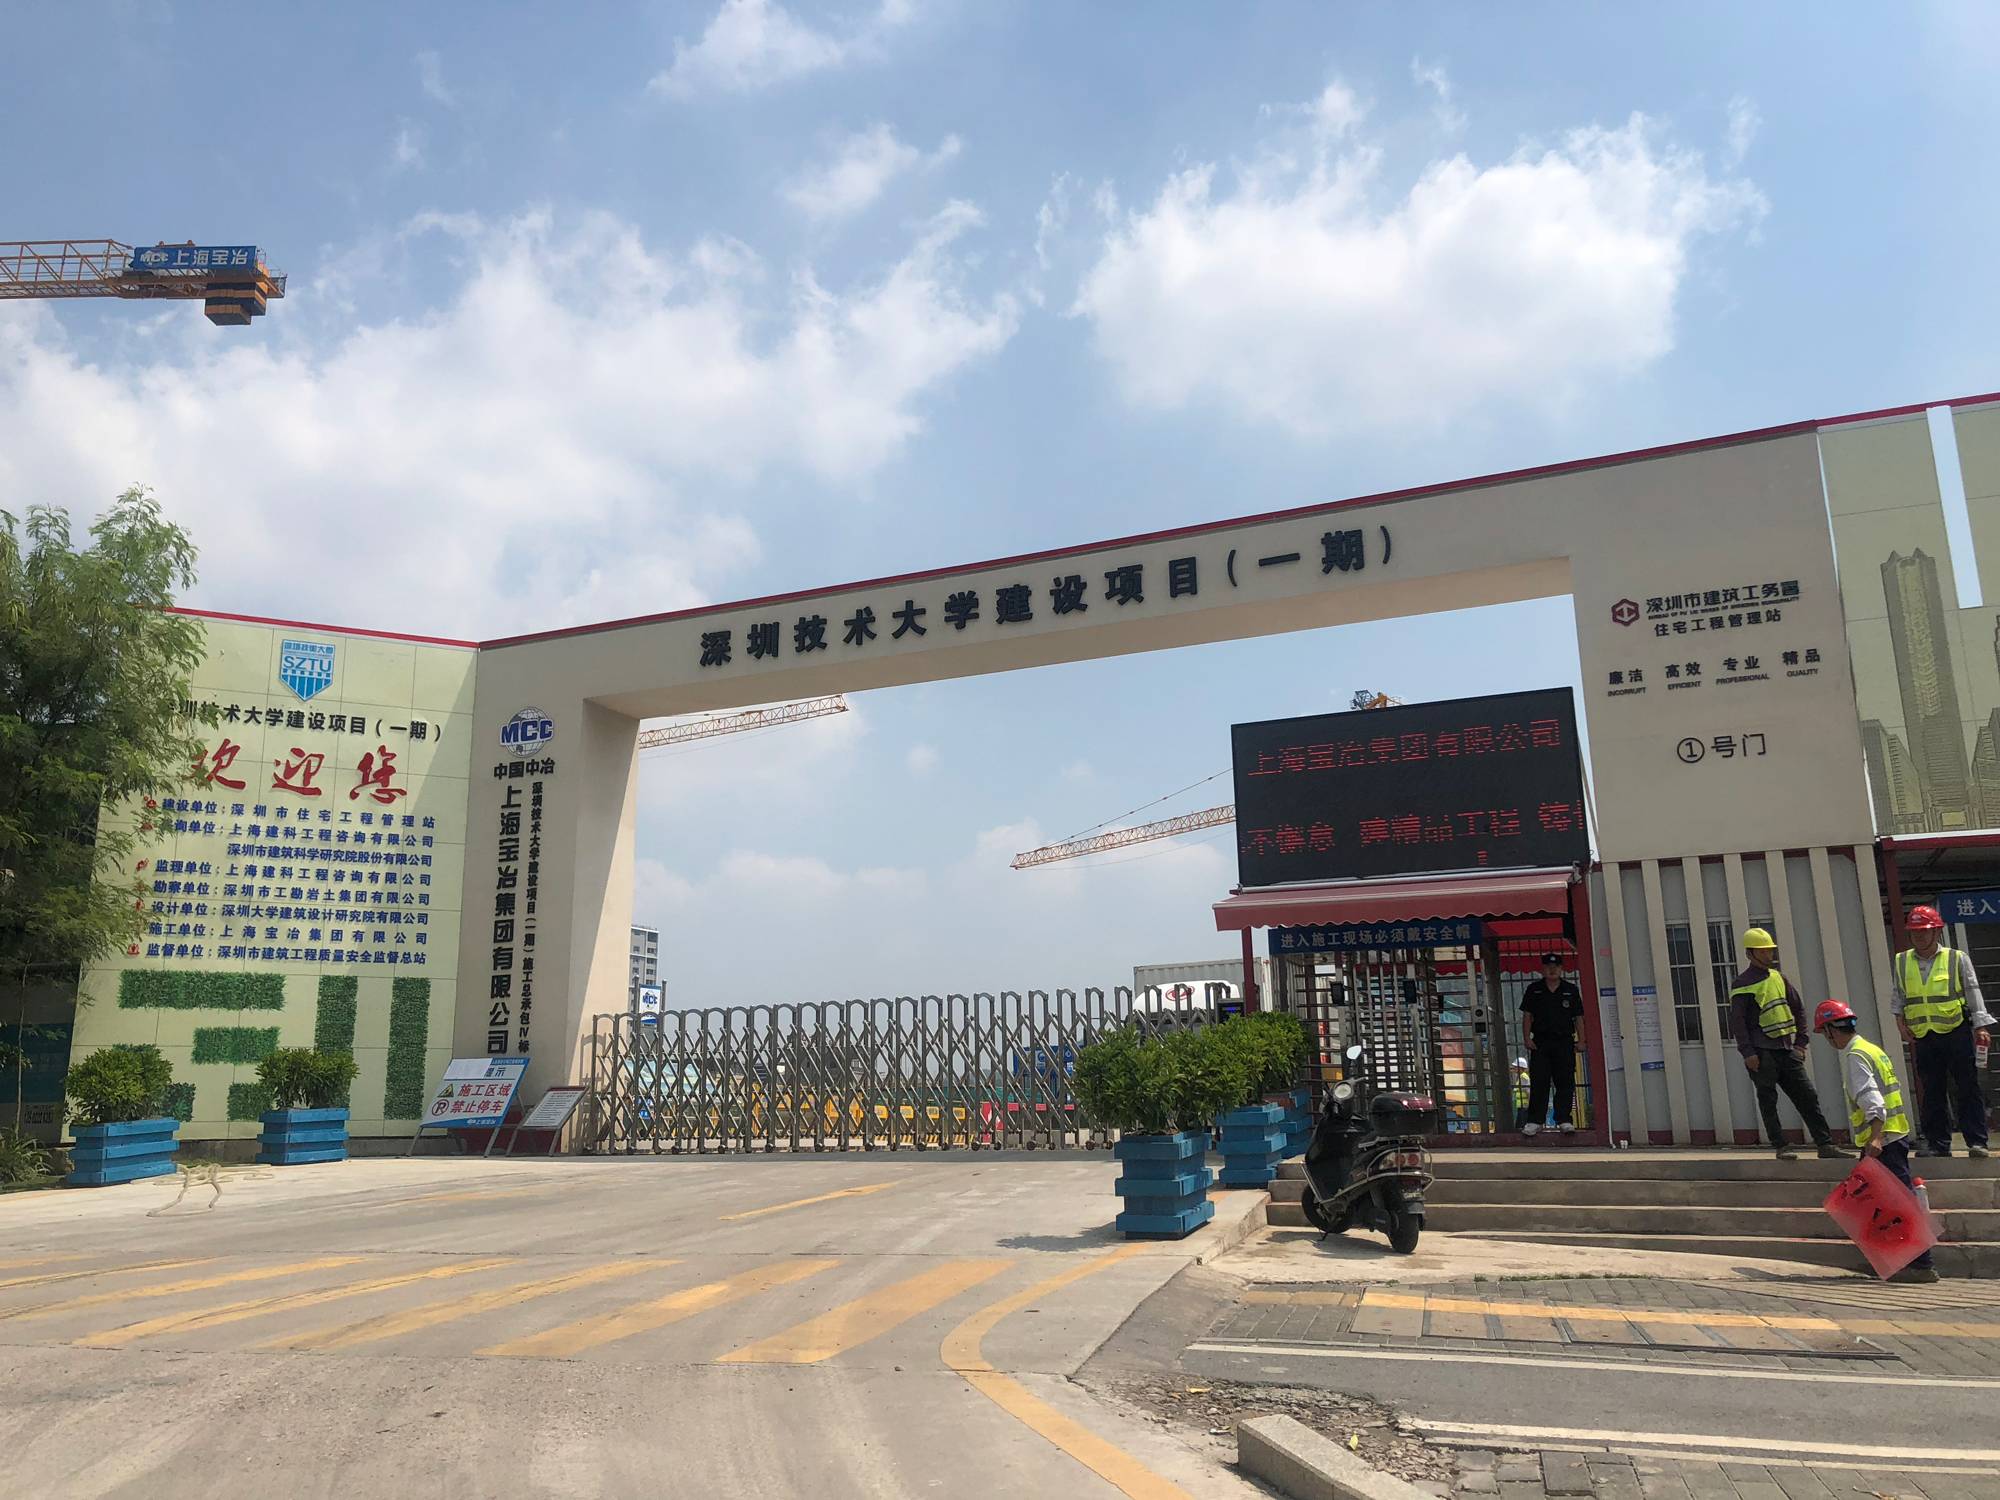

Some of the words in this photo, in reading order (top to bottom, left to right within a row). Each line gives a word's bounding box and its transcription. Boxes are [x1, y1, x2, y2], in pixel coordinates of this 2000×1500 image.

[172, 249, 248, 266] 上海宝冶
[700, 526, 1392, 667] 深圳技术大学建设项目（一期）
[1646, 580, 1800, 613] 深圳市建筑工务署
[1654, 608, 1781, 637] 住宅工程管理站
[283, 655, 332, 672] SZTU
[1608, 668, 1643, 685] 廉洁
[1665, 661, 1702, 679] 高效
[1722, 655, 1760, 671] 专业
[1781, 648, 1821, 666] 精品
[1715, 673, 1770, 686] PROFESSIONAL
[1786, 667, 1819, 678] QUALITY
[501, 720, 553, 743] MCC
[493, 757, 556, 780] 中国中冶
[164, 819, 434, 848] 询单位：上海建科工程咨询有限公司
[227, 842, 433, 868] 深圳市建筑科学研究院股份有限公司
[487, 785, 522, 1054] 上海宝冶集团有限公司
[1956, 898, 2000, 917] 进入
[1280, 924, 1471, 949] 进入施工现场必须戴安全帽
[457, 1083, 512, 1097] 施工区域
[450, 1100, 505, 1114] 禁止停车
